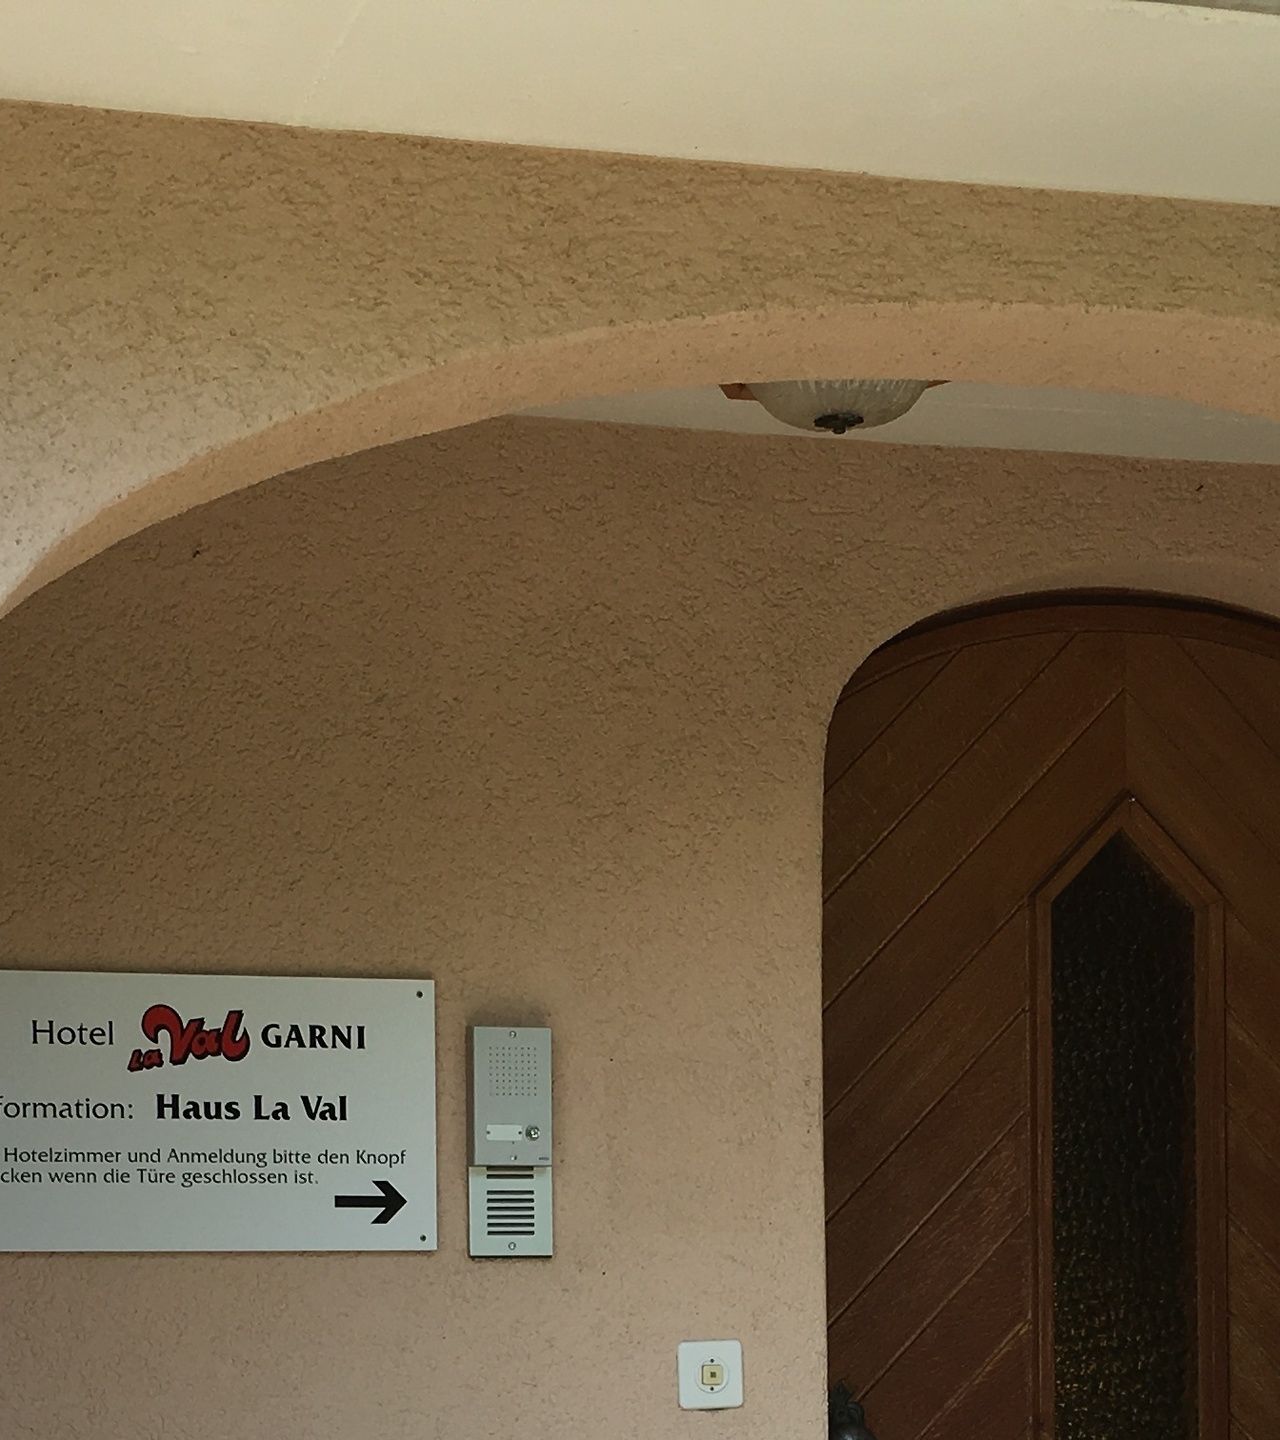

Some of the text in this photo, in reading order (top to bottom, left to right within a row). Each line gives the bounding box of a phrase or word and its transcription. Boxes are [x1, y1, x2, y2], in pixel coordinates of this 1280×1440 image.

[31, 1004, 366, 1073] Hotel La Val GARNI
[156, 1094, 241, 1121] Haus
[254, 1095, 290, 1121] La
[300, 1095, 348, 1122] Val
[4, 1147, 121, 1164] Hotelzimmer
[128, 1148, 161, 1164] und
[167, 1148, 267, 1169] Anmeldung
[272, 1149, 311, 1165] bitte
[317, 1149, 350, 1165] den
[356, 1149, 406, 1169] Knopf
[48, 1172, 97, 1184] wenn
[103, 1168, 131, 1184] die
[136, 1168, 176, 1184] Türe
[181, 1168, 288, 1188] geschlossen
[293, 1169, 319, 1185] ist.
